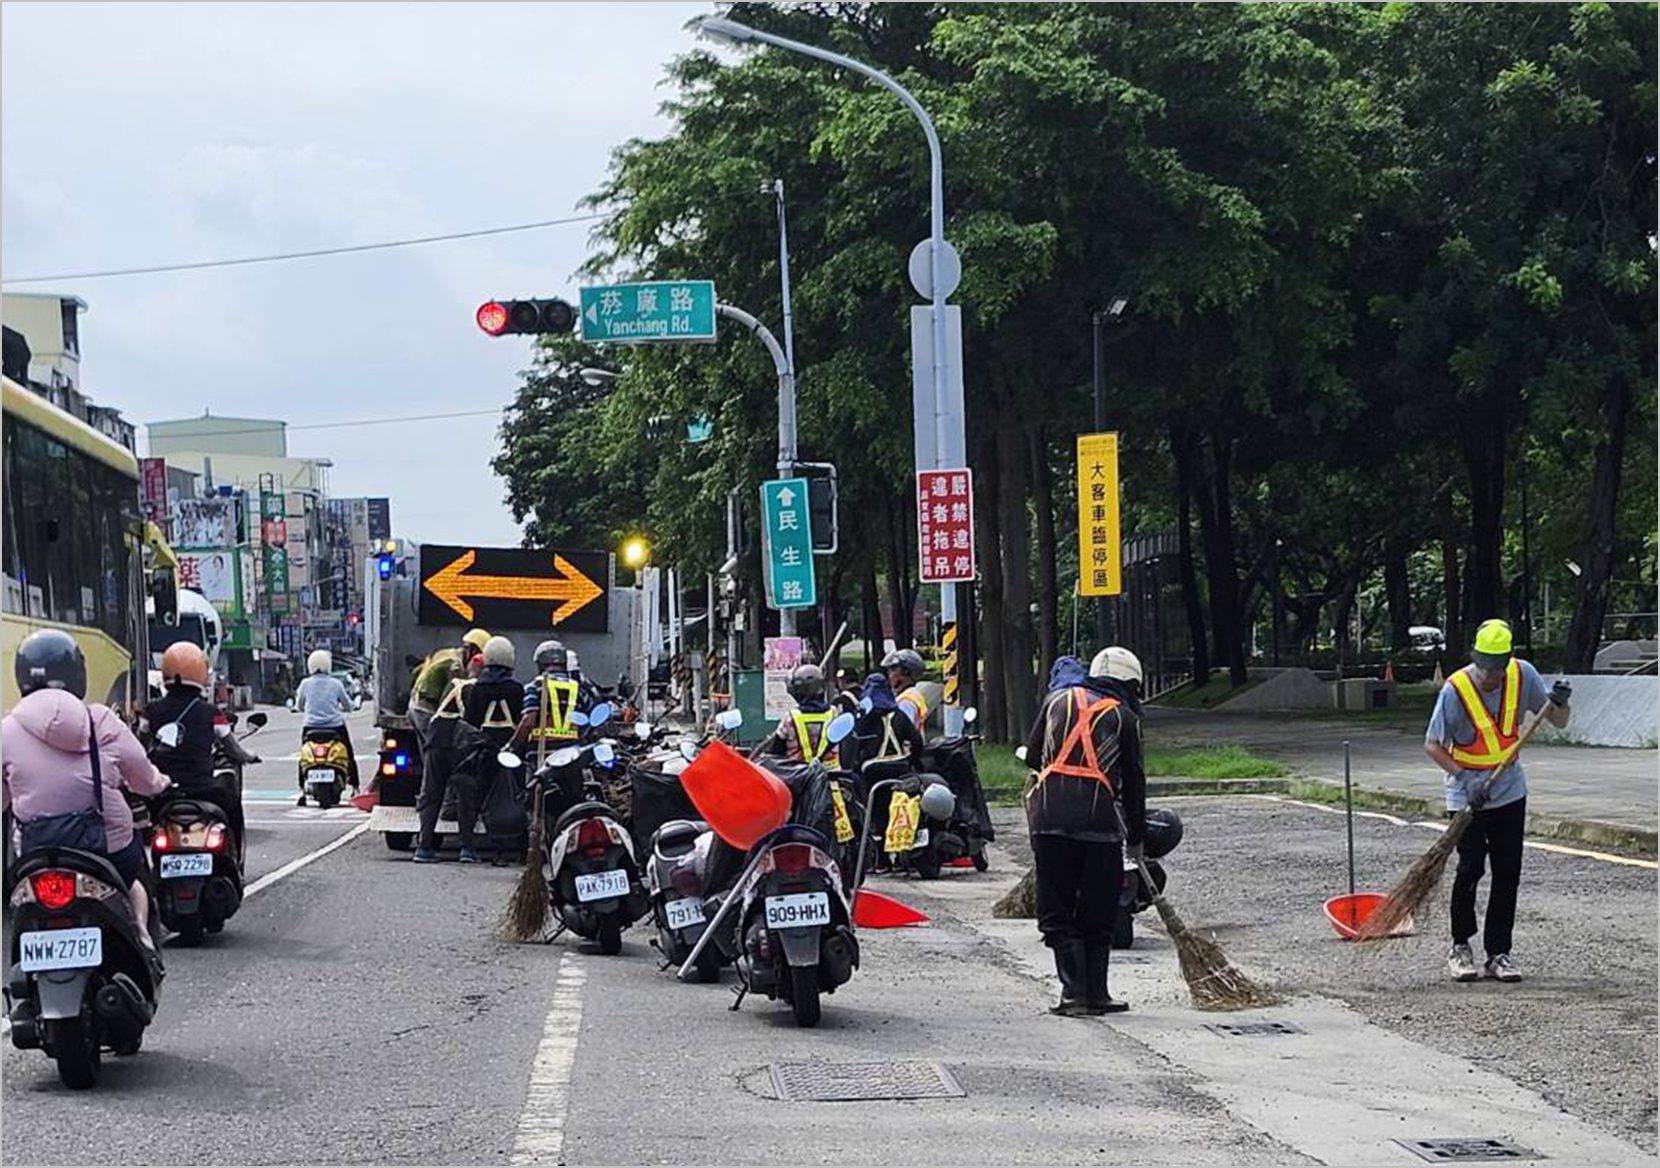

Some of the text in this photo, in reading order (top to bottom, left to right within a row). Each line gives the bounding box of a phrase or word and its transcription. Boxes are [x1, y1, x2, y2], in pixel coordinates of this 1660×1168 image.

[604, 314, 694, 337] Yanchang Rd.
[777, 510, 803, 600] 民生路
[931, 476, 951, 576] 違者拖吊
[951, 475, 971, 576] 嚴禁違停
[1091, 461, 1108, 588] 大客車臨停區
[23, 938, 97, 962] NWW-2787
[768, 903, 828, 924] 909-HHX
